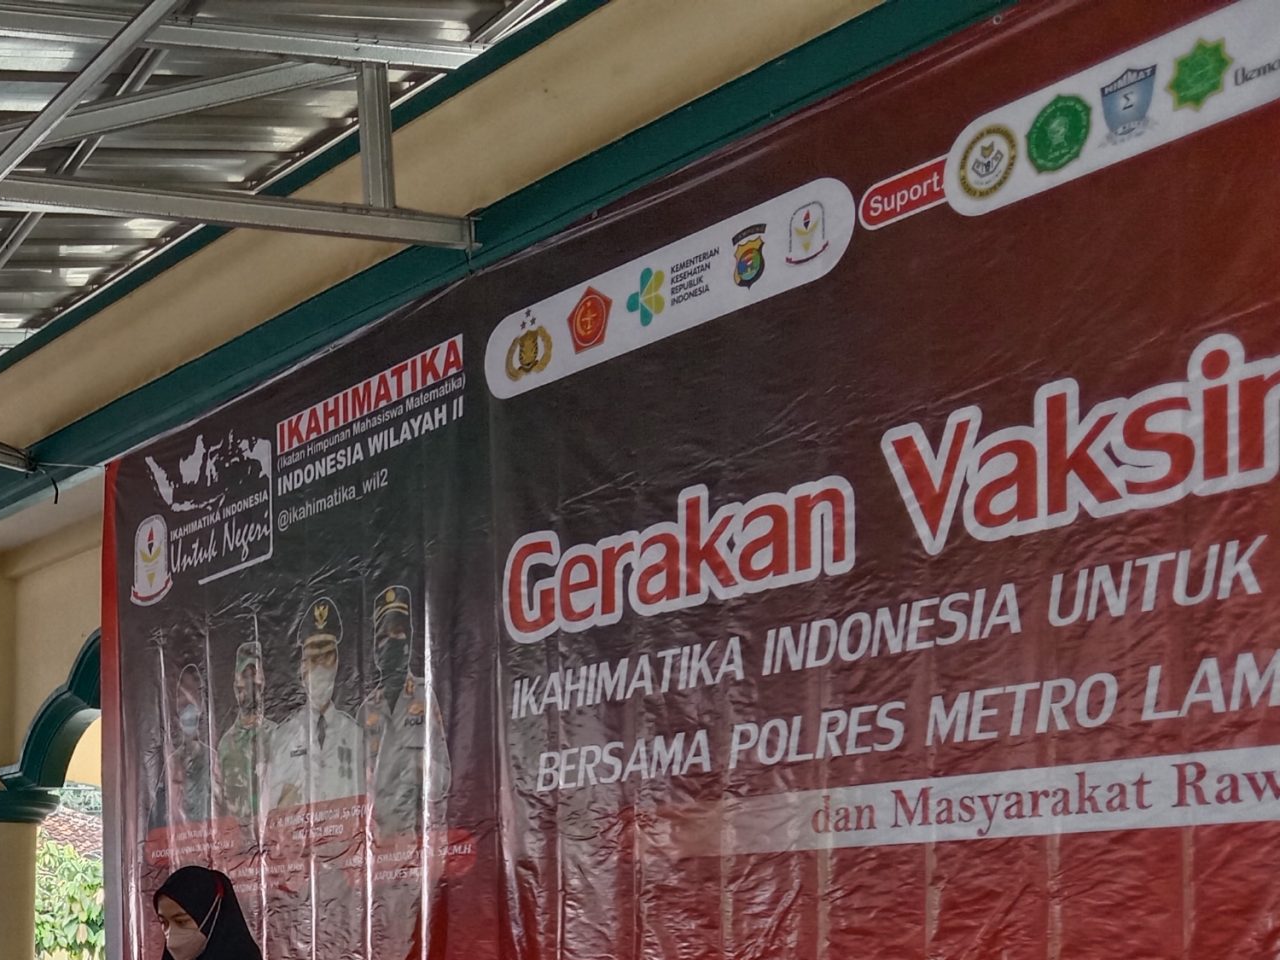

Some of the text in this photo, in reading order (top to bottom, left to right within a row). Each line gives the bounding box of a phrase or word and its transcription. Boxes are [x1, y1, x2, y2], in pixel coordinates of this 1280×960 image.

[671, 247, 720, 274] KEMENTERIAN
[671, 262, 711, 285] KESEHATAN
[671, 275, 704, 296] REPUBLIK
[671, 285, 710, 306] INDONESIA
[278, 338, 463, 454] IKAHIMATIKA
[278, 372, 466, 472] (Ikatan Himpunan Mahasiswa Matematika)
[278, 395, 464, 497] INDONESIA WILAYAH II
[170, 490, 269, 541] IKAHIMATIKA INDONESIA
[277, 467, 389, 532] @ikahimatika_wil2
[170, 510, 271, 575] Untuk Negeri
[503, 476, 855, 643] Gerakan
[511, 534, 1270, 721] IKAHIMATIKA INDONESIA UNTUK
[536, 647, 1280, 793] BERSAMA POLRES METRO LAM
[810, 760, 1280, 838] dan Masyarakat Raw
